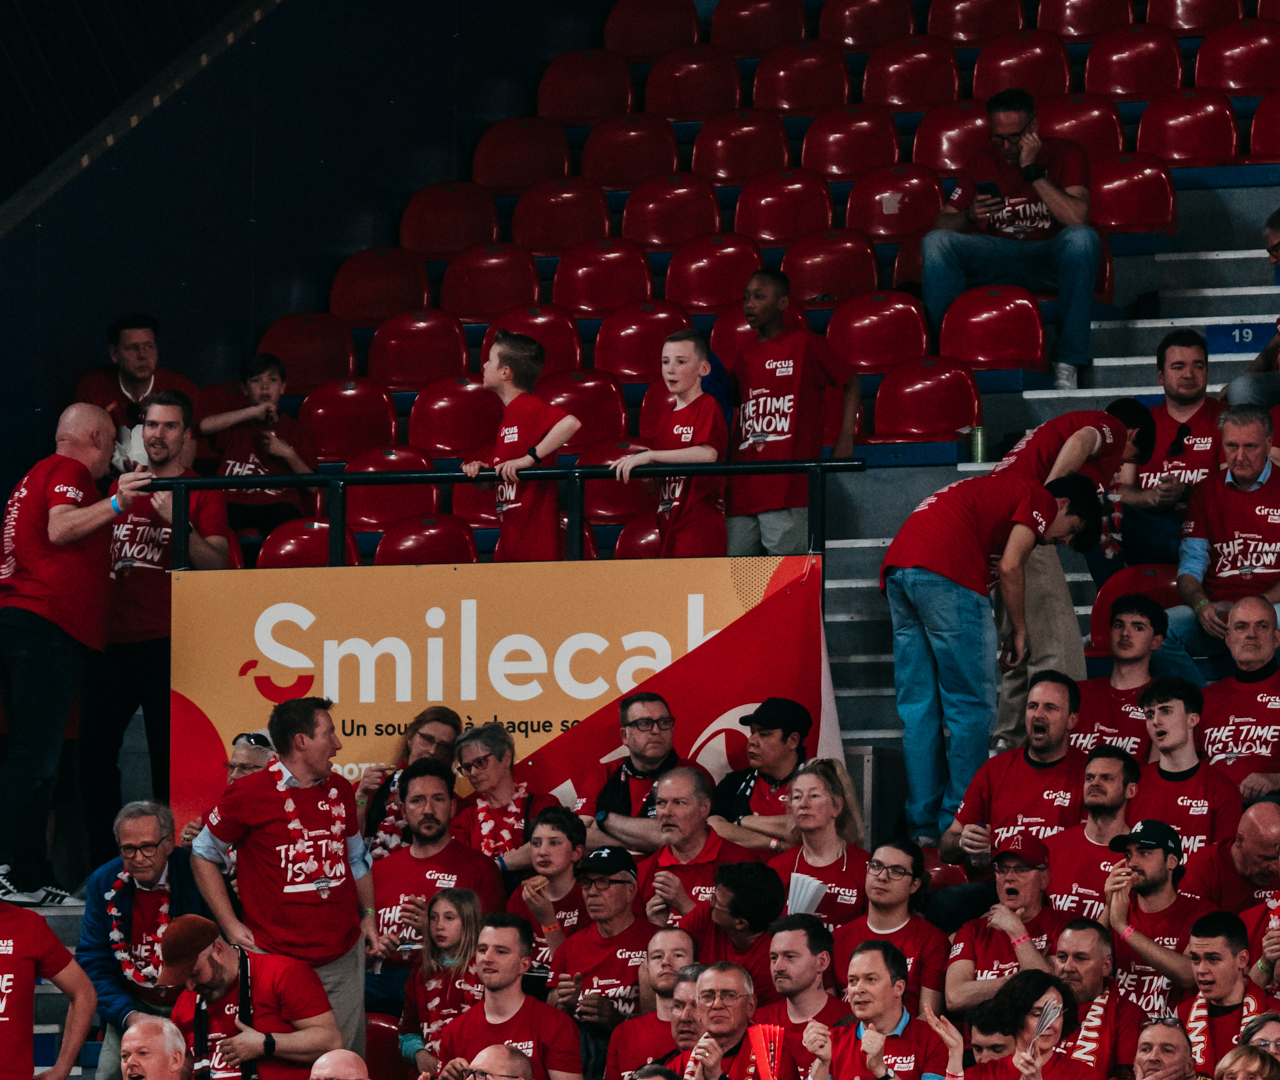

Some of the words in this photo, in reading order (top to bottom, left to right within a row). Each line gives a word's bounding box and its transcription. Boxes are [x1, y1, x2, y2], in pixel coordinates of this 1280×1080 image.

[1231, 328, 1253, 344] 19
[1184, 435, 1213, 446] Circus
[1214, 539, 1243, 559] THE
[341, 719, 367, 737] Un
[483, 714, 554, 739] aque
[1240, 725, 1280, 745] TIME
[1177, 797, 1209, 807] Circus
